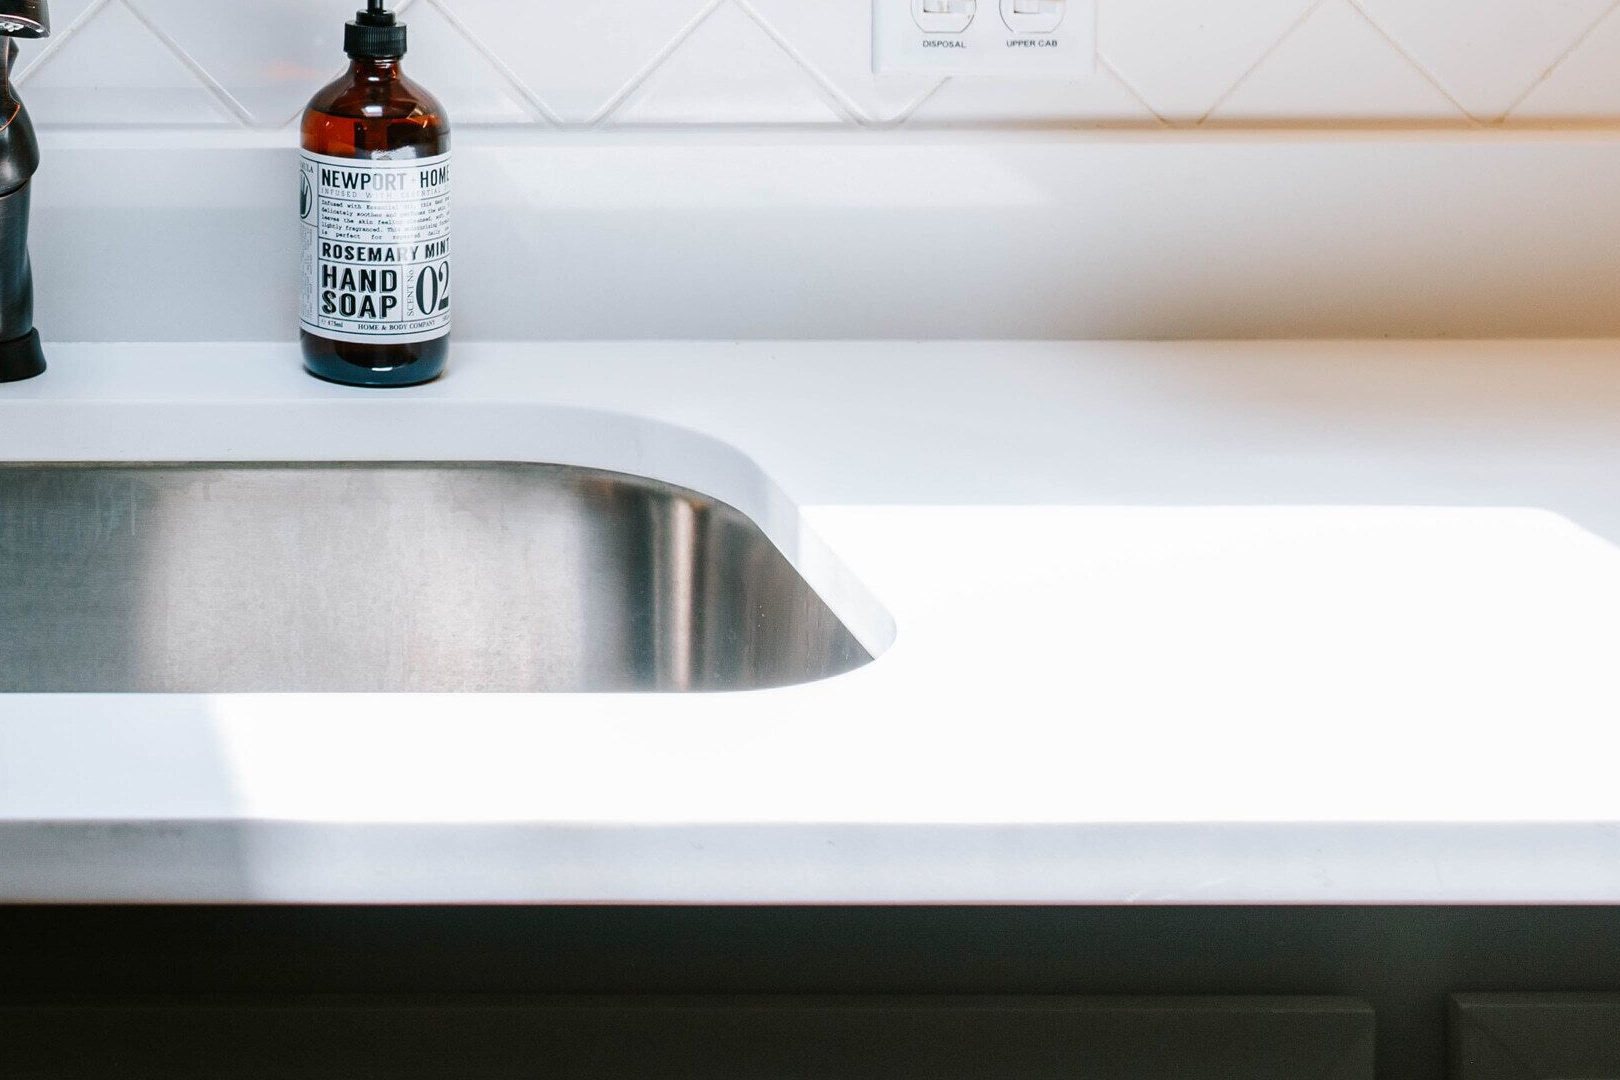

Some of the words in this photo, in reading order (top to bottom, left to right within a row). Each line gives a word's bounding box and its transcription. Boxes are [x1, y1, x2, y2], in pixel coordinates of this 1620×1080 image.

[922, 40, 967, 48] DISPOSAL
[1007, 40, 1036, 48] UPPER
[1038, 40, 1058, 48] CAB
[321, 168, 407, 191] NEWPORT
[420, 164, 450, 188] HOME
[321, 188, 357, 198] INFUSED
[322, 242, 419, 263] ROSEMARY
[425, 237, 450, 259] MINT
[322, 264, 398, 294] HAND
[416, 261, 449, 315] 02
[322, 290, 398, 320] SOAP
[409, 320, 436, 329] COMPANY
